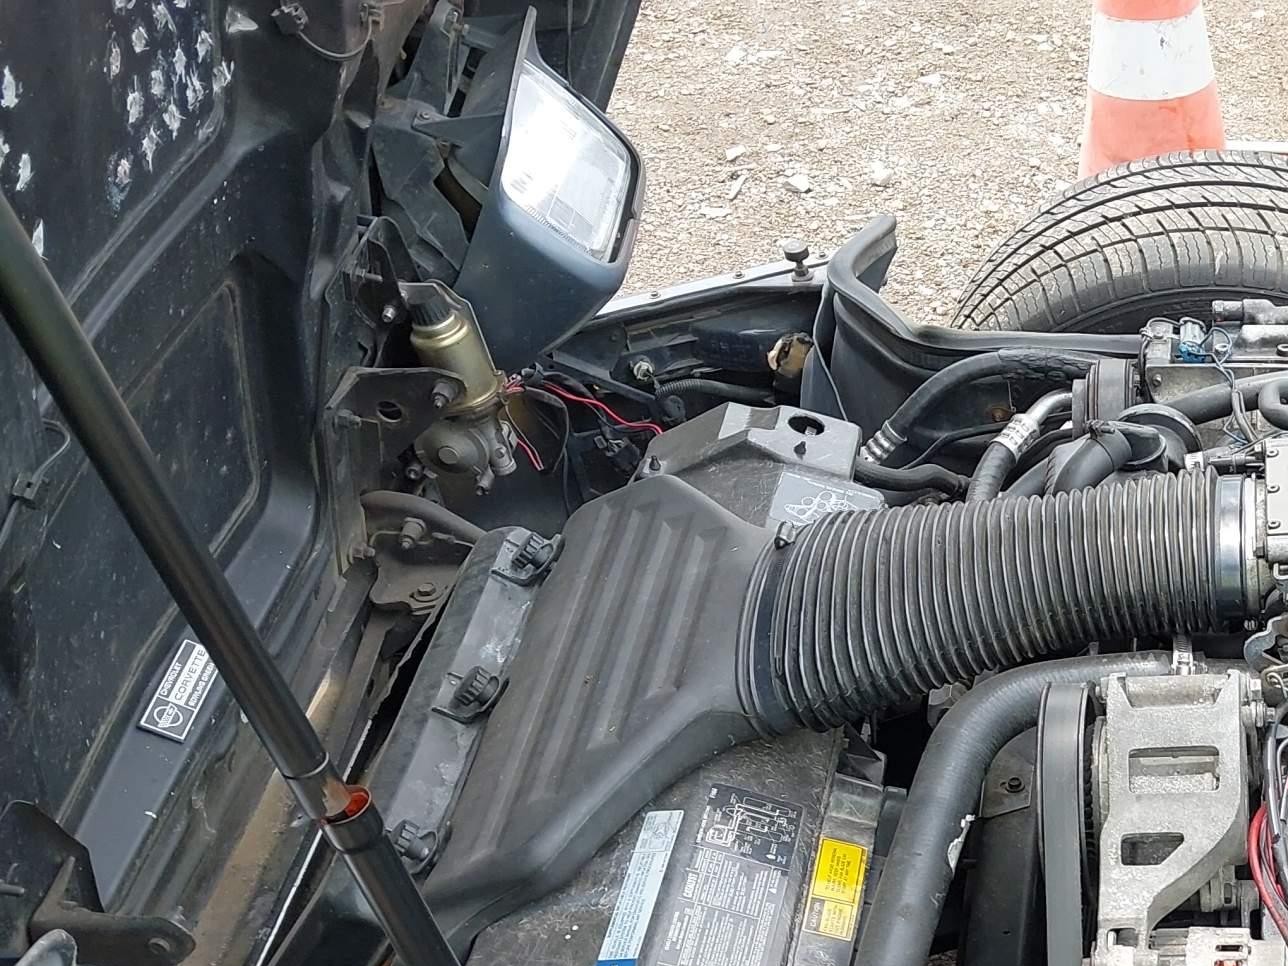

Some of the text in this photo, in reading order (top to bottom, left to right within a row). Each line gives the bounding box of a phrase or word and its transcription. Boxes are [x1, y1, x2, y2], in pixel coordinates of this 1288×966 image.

[159, 661, 184, 696] CHEVROLET
[174, 649, 206, 701] CORVETTE
[682, 873, 699, 899] CATALYST
